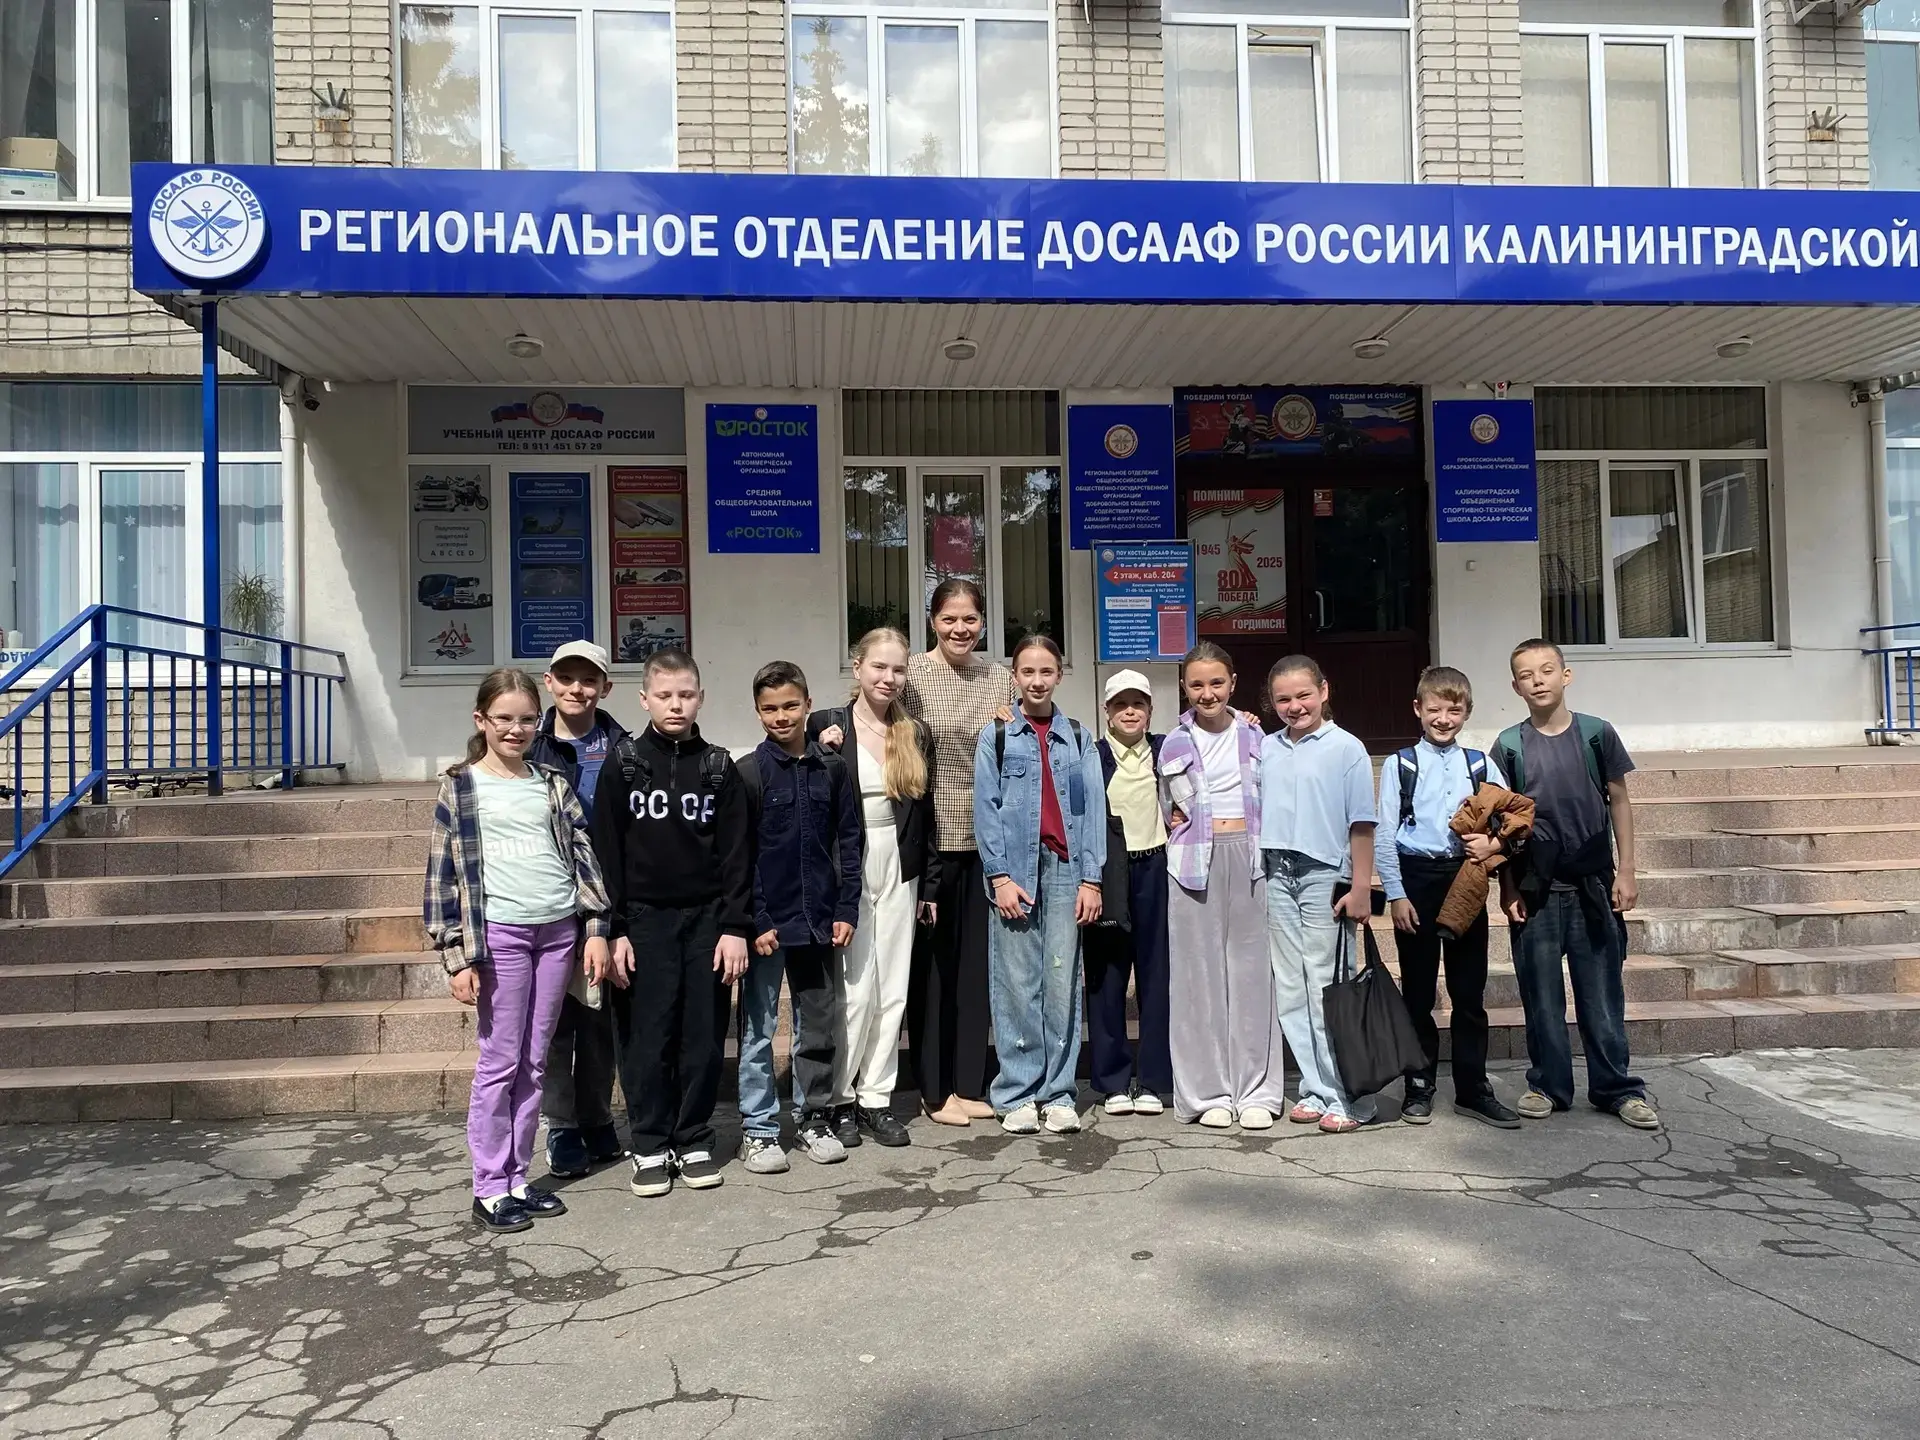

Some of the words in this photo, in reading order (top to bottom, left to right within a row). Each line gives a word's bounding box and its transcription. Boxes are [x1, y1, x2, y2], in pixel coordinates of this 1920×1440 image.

[150, 171, 203, 222] ДОСААФ
[211, 171, 262, 221] РОССИИ
[300, 209, 719, 258] РЕГИОНАЛЬНОЕ
[734, 216, 1025, 268] ОТДЕЛЕНИЕ
[1037, 221, 1240, 270] ДОСААФ
[1256, 223, 1450, 266] РОССИИ
[1464, 218, 1919, 274] КАЛИНИНГРАДСКОЙ
[1226, 393, 1253, 401] ТОГДА!
[1329, 393, 1366, 401] ПОБЕДИМ
[1374, 392, 1407, 400] СЕЙЧАС!
[442, 428, 504, 440] УЧЕБНЫЙ
[507, 429, 546, 441] ЦЕНТР
[550, 428, 604, 441] ДОСААФ
[606, 429, 656, 440] РОССИИ
[737, 421, 809, 437] РОСТОК
[497, 442, 520, 451] ТЕЛ:
[522, 442, 529, 450] 8
[531, 442, 550, 451] 911
[733, 459, 793, 467] НЕКОММЕРЧЕСКАЯ
[745, 489, 782, 497] СРЕДНЯЯ
[1193, 489, 1244, 502] ПОМНИМ!
[1454, 488, 1520, 496] КАЛИНИНГРАДСКАЯ
[714, 499, 812, 507] ОБЩЕОБРАЗОВАТЕЛЬНАЯ
[1460, 497, 1515, 505] ОБЪЕДИНЕННАЯ
[750, 509, 778, 517] ШКОЛА
[725, 526, 803, 539] «РОСТОК»
[1196, 543, 1221, 556] 1945
[1256, 556, 1283, 568] 2025
[1113, 571, 1119, 579] 2
[1120, 571, 1142, 580] этаж,
[1143, 570, 1160, 579] каб.
[1161, 570, 1176, 579] 204
[1217, 569, 1242, 589] 80
[1217, 591, 1259, 604] ПОБЕДА!
[1232, 618, 1285, 631] ГОРДИМСЯ!
